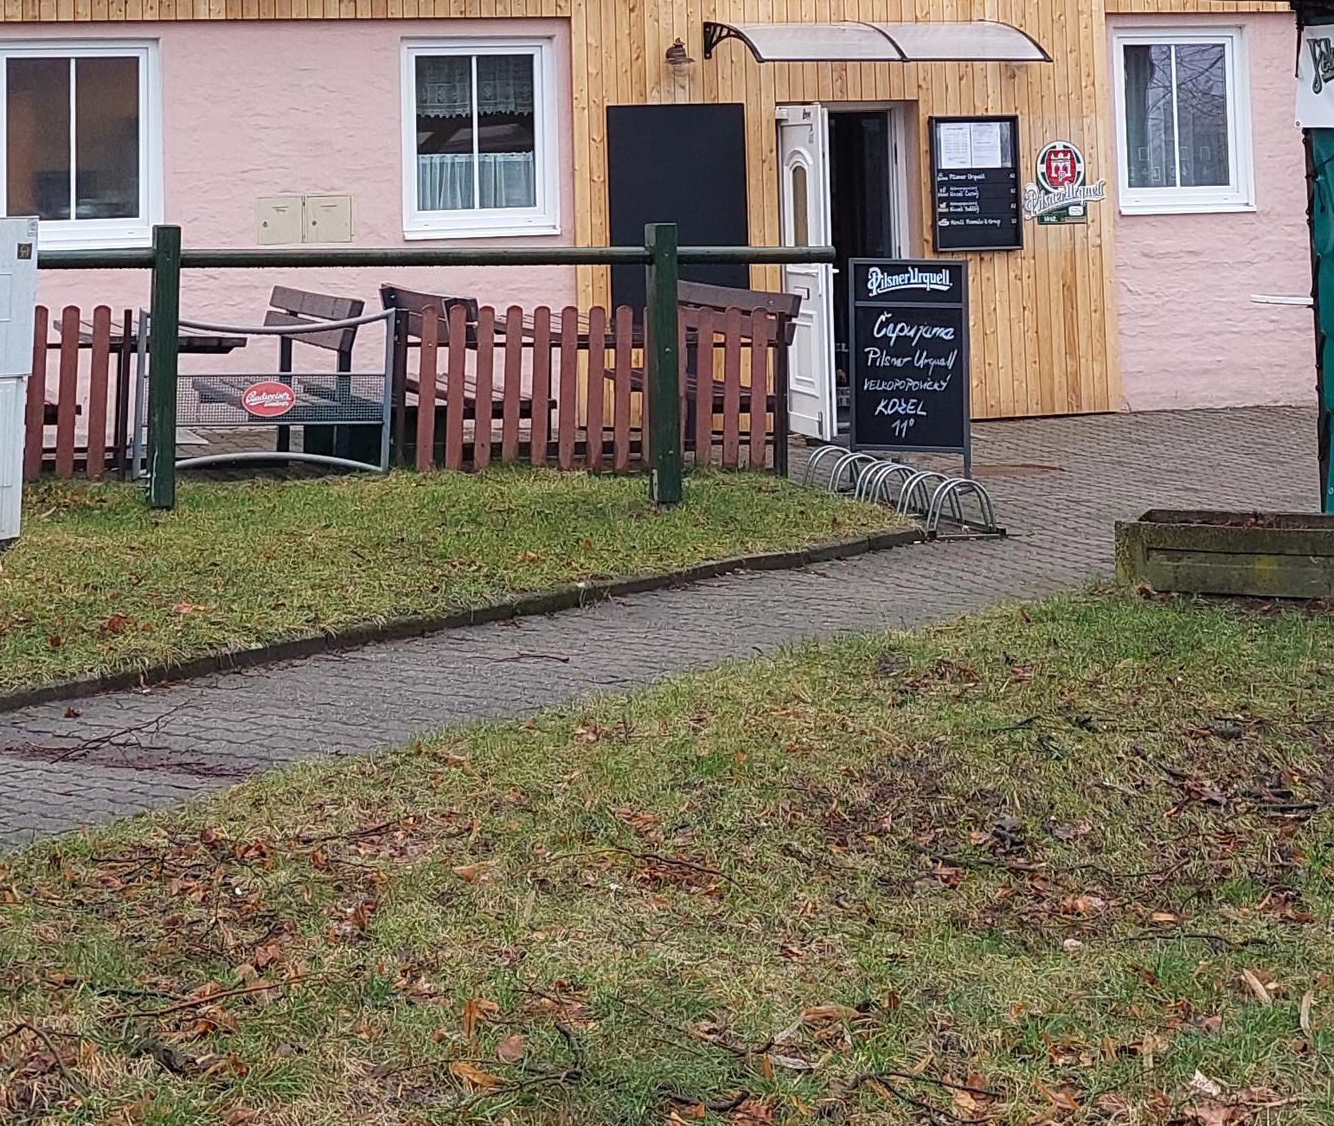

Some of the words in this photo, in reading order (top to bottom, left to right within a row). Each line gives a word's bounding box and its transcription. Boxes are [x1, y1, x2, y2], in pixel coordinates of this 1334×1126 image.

[1023, 183, 1067, 220] Pilsner
[1064, 178, 1107, 207] Urquell
[867, 266, 911, 297] Pilsner
[908, 265, 950, 291] Urquell
[864, 347, 912, 367] Pilsner
[914, 348, 957, 376] Urquell
